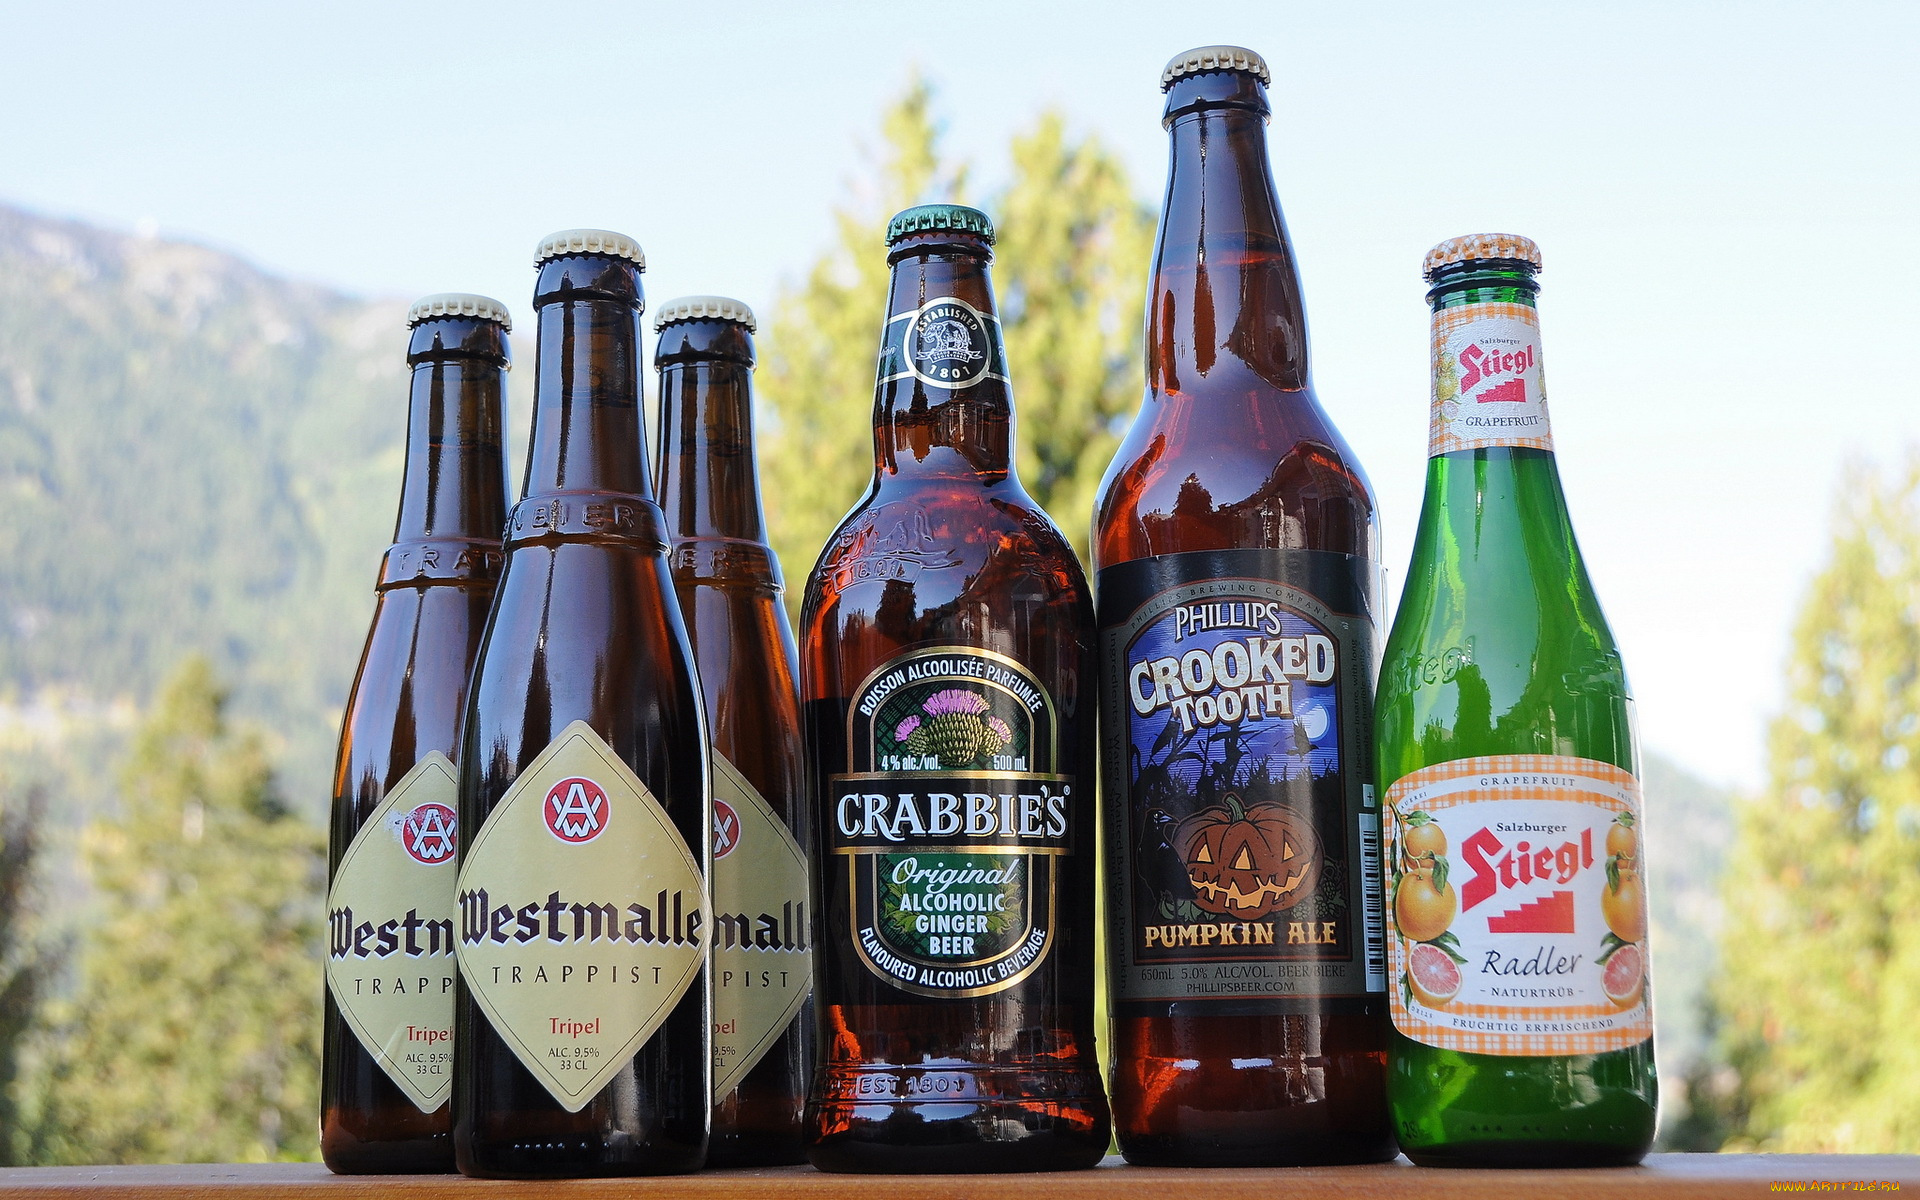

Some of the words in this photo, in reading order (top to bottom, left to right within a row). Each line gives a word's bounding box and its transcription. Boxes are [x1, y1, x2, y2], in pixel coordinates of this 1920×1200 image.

[916, 308, 978, 333] ESTABLISHED
[929, 365, 970, 378] 1801
[1459, 343, 1534, 395] Stiegl
[1465, 415, 1539, 427] GRAPEFRUIT
[1131, 593, 1181, 629] PHILLIPS
[1190, 584, 1256, 596] BREWING
[1265, 586, 1328, 620] COMPANY
[1175, 602, 1281, 642] PHILLIPS
[1129, 634, 1336, 715] CROOKED
[859, 669, 906, 718] BOISSON
[908, 657, 983, 681] ALCOOLISÉE
[985, 663, 1044, 715] PARFUMÉE
[1171, 684, 1294, 733] TOOTH
[902, 753, 942, 770] alc./vol.
[993, 755, 1012, 771] 500
[1480, 776, 1576, 788] GRAPEFRUIT
[836, 784, 1067, 842] CRABBIE'S
[1496, 822, 1567, 834] Salzburger
[892, 857, 1021, 895] Original
[1461, 826, 1595, 914] Stiegl
[900, 893, 1006, 912] ALCOHOLIC
[458, 887, 702, 948] Westmalle
[915, 915, 989, 934] GINGER
[1144, 922, 1274, 948] PUMPKIN
[1287, 921, 1337, 945] ALE
[929, 936, 975, 955] BEER
[860, 927, 917, 981] FLAVOURED
[918, 968, 997, 988] ALCOHOLIC
[997, 927, 1047, 980] BEVERAGE
[1480, 946, 1584, 977] Radler
[492, 966, 662, 985] TRAPPIST
[722, 971, 789, 988] PIST
[1181, 967, 1208, 979] 5.0%
[1186, 981, 1296, 994] PHILLIPSBEER.COM
[1491, 986, 1575, 998] NATURTRÜB
[549, 1017, 601, 1038] Tripel
[1452, 1017, 1519, 1032] FRUCHTIG
[1525, 1018, 1615, 1032] ERFRISCHEND
[405, 1053, 427, 1063] ALC.
[547, 1047, 571, 1058] ALC.
[416, 1064, 428, 1075] 33
[429, 1064, 443, 1075] CL
[560, 1060, 572, 1070] 33
[574, 1060, 588, 1070] CL
